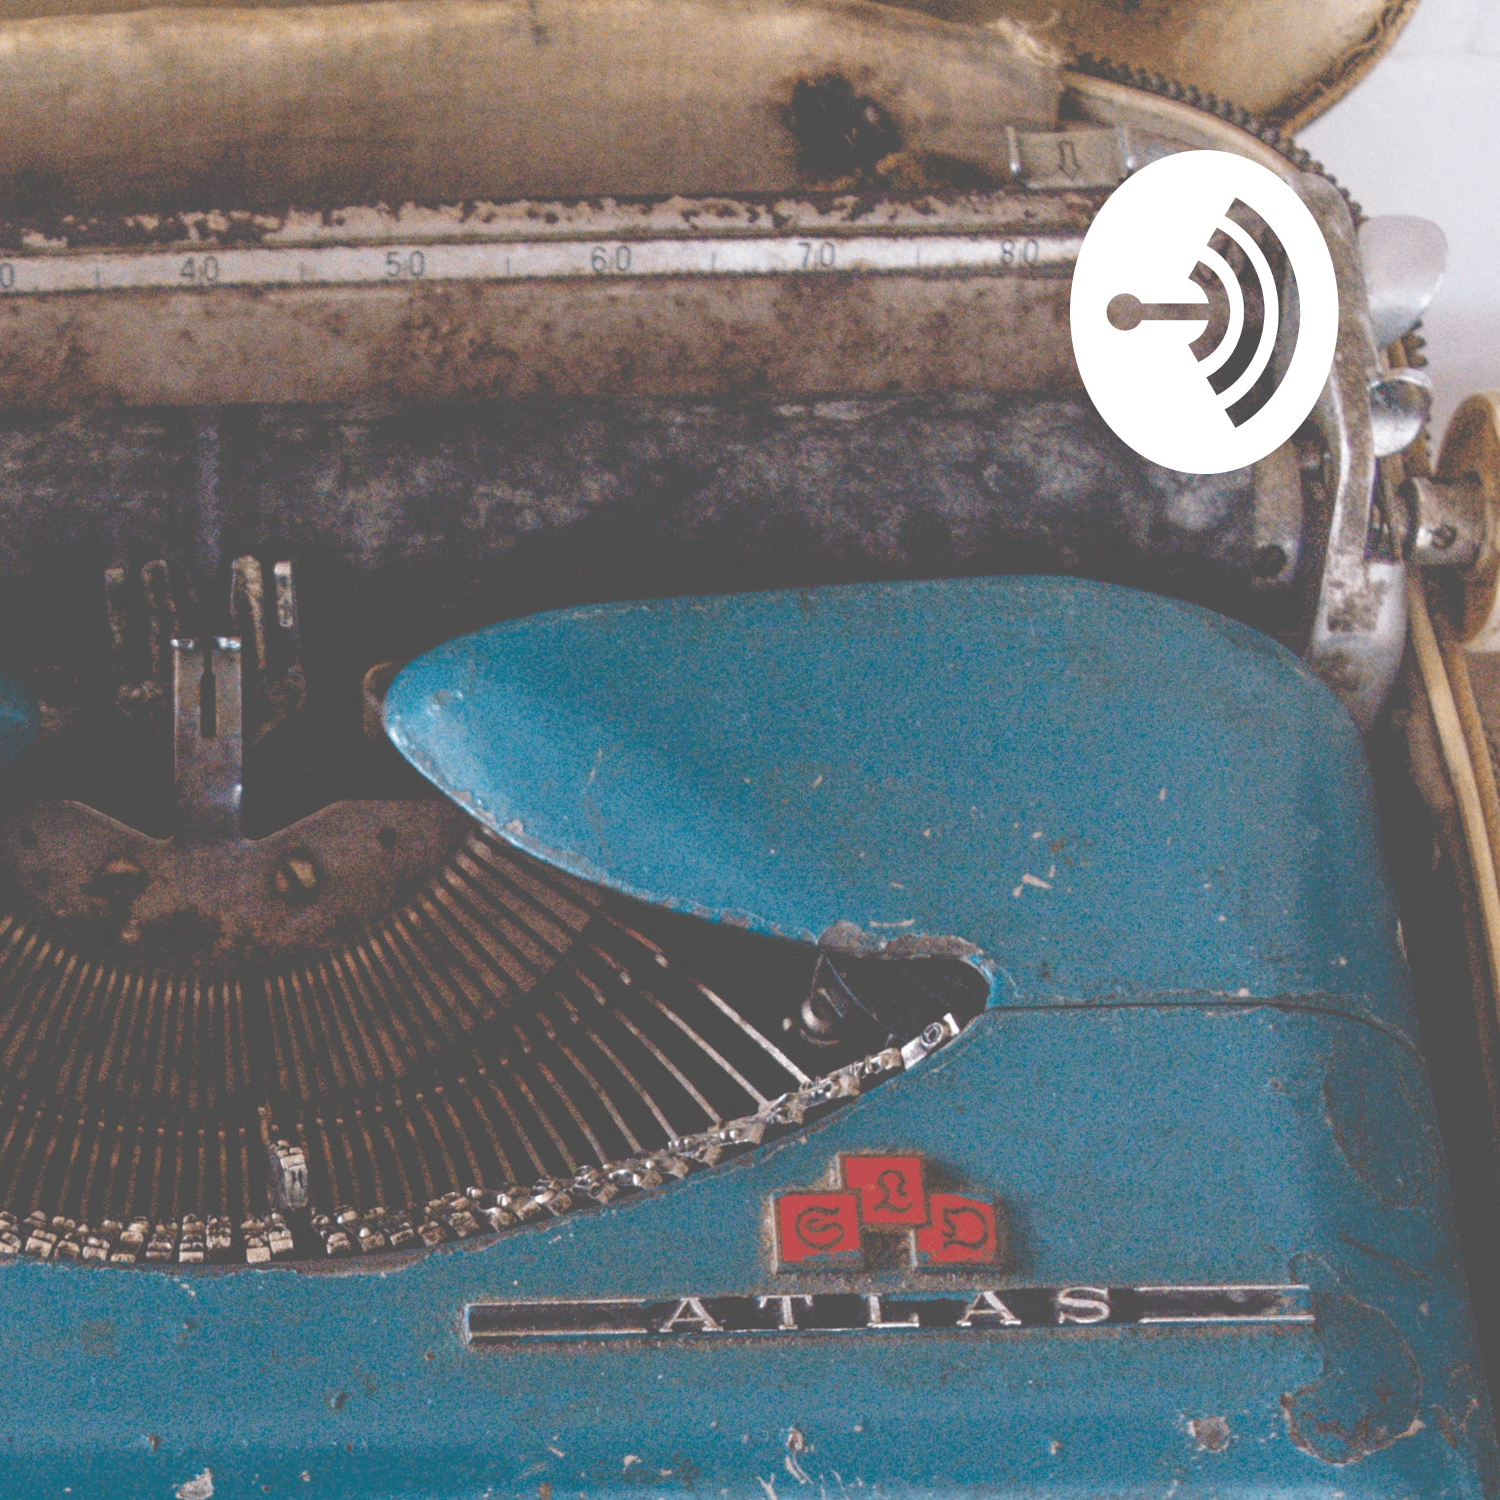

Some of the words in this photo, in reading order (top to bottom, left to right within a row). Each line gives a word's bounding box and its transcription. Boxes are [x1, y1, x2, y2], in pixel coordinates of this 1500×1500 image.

[179, 255, 220, 283] 40
[385, 250, 425, 277] 50
[591, 244, 632, 272] 60
[798, 241, 836, 267] 70
[1000, 237, 1039, 264] 80
[659, 1286, 1112, 1333] ATLAS
